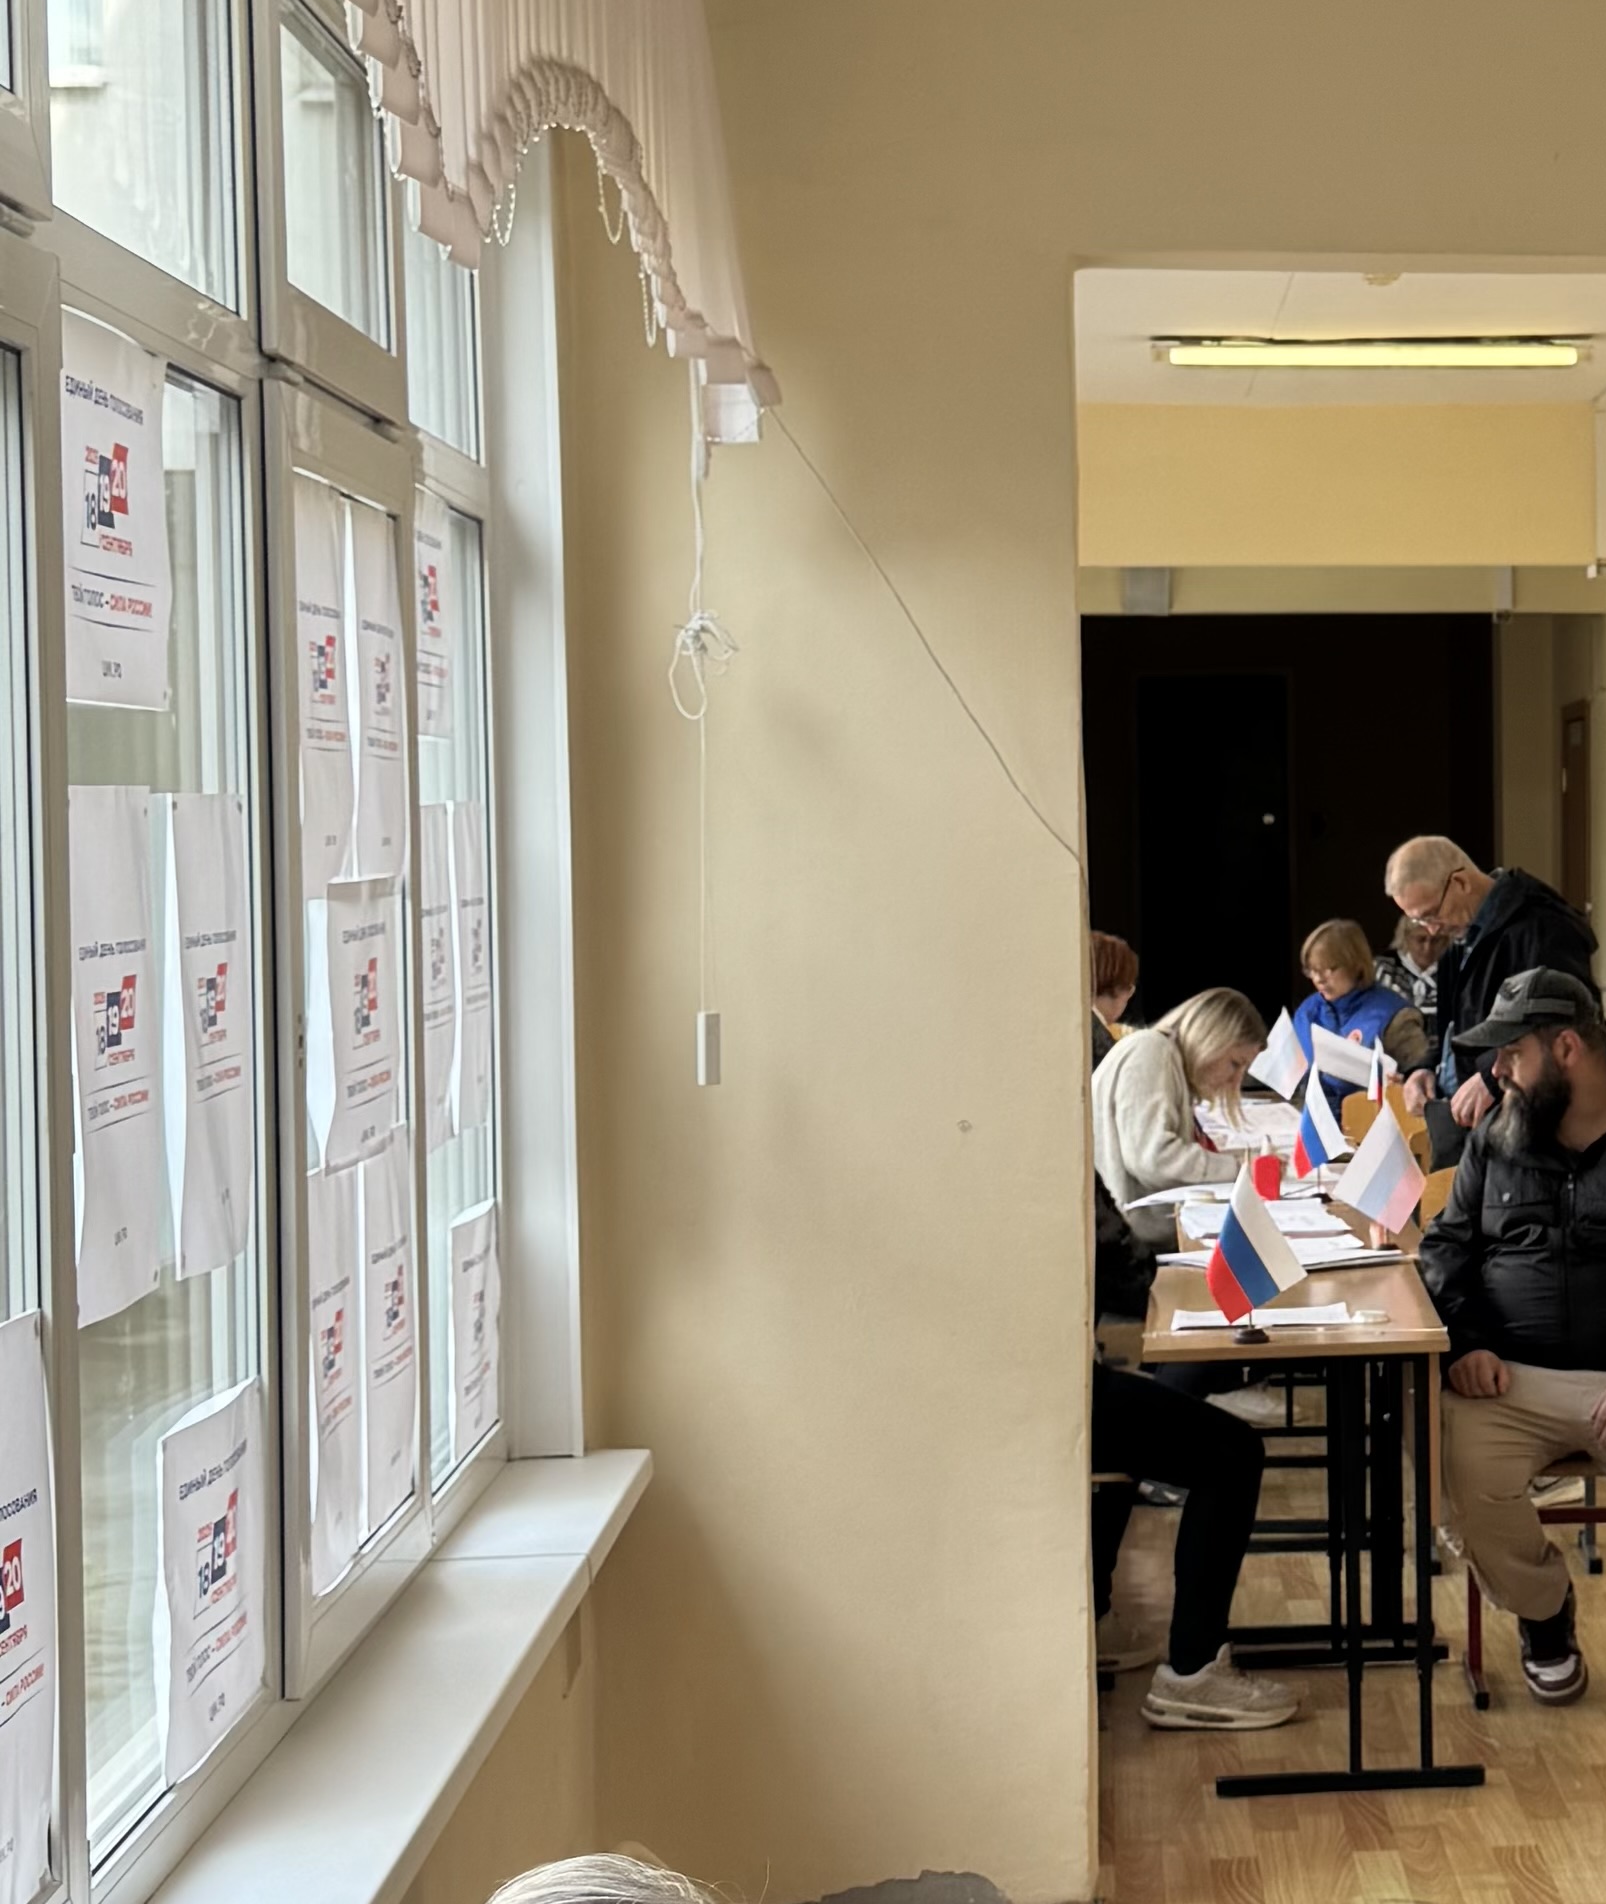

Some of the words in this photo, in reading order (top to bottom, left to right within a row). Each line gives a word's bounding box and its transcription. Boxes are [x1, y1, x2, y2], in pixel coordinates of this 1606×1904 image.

[85, 493, 97, 530] 18
[99, 473, 110, 513] 19
[111, 458, 127, 499] 20
[95, 1026, 106, 1055] 18
[107, 1006, 120, 1036] 19
[121, 989, 134, 1018] 20
[4, 1556, 21, 1597] 20
[198, 1561, 210, 1599] 18
[213, 1532, 226, 1570] 19
